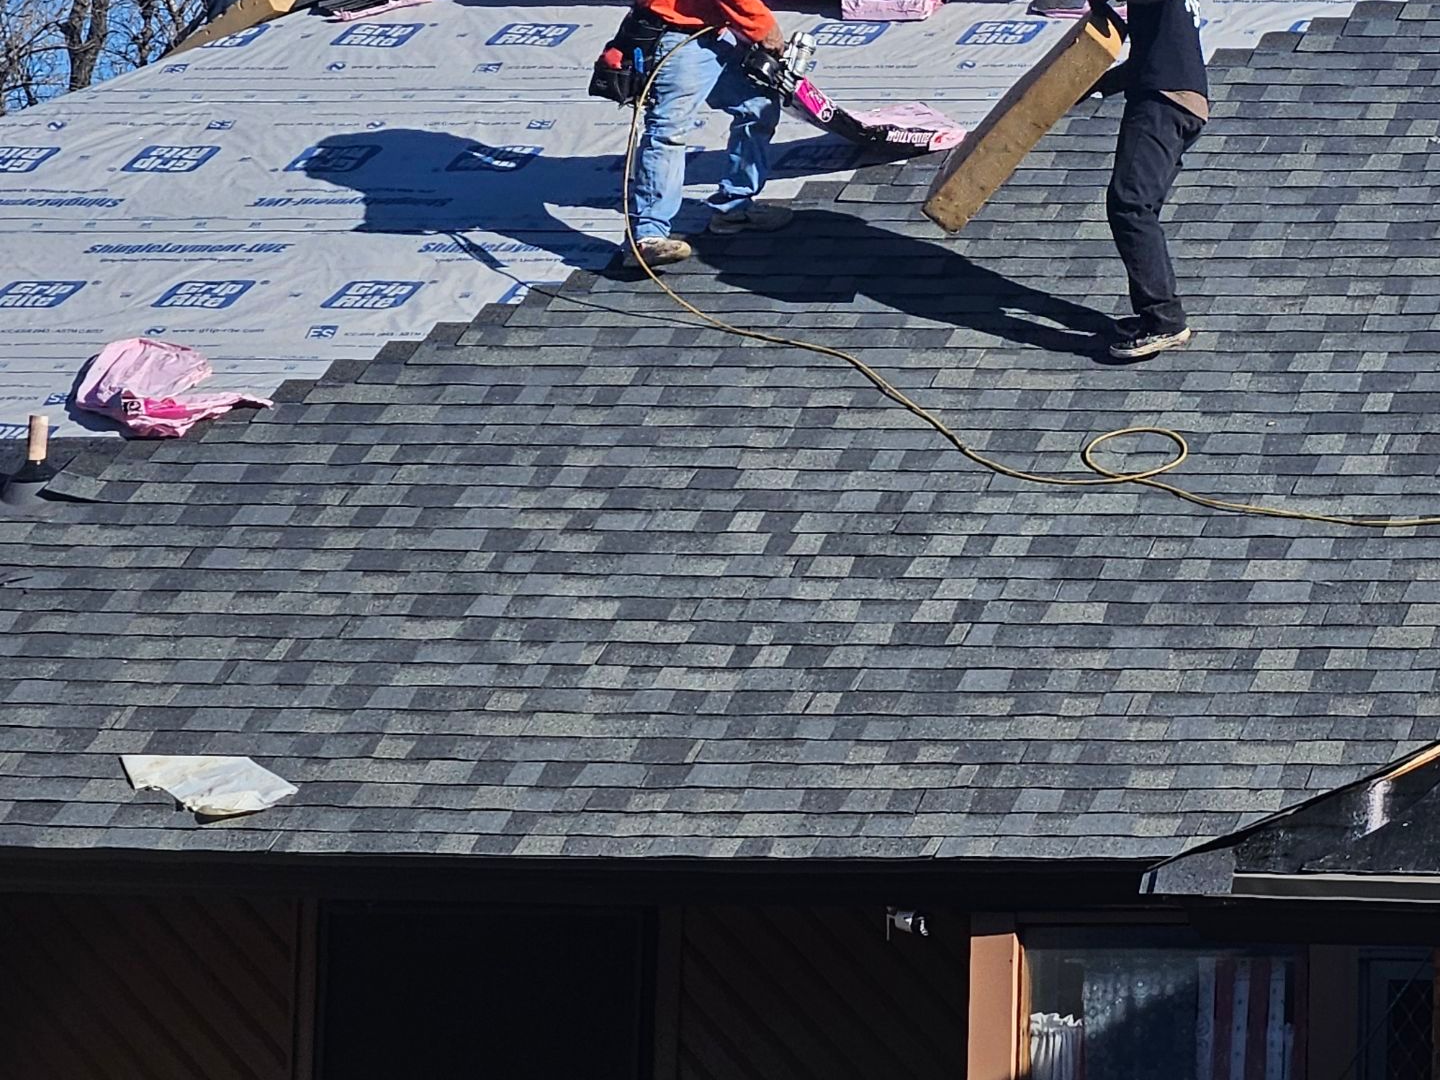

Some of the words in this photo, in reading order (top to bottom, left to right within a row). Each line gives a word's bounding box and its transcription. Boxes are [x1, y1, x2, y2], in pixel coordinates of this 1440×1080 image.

[351, 24, 410, 36] Grip
[506, 24, 569, 37] Grip
[818, 23, 882, 36] Grip
[978, 22, 1037, 35] Grip
[340, 34, 399, 46] Rite
[495, 34, 555, 46] Rite
[814, 34, 866, 45] Rite
[967, 33, 1023, 45] Rite
[150, 147, 212, 159] Rite
[132, 157, 196, 171] Grip
[7, 282, 75, 295] Grip
[176, 282, 244, 296] Grip
[348, 282, 414, 296] Grip
[1, 294, 56, 307] Rite
[160, 294, 226, 308] Rite
[331, 295, 397, 308] Rite
